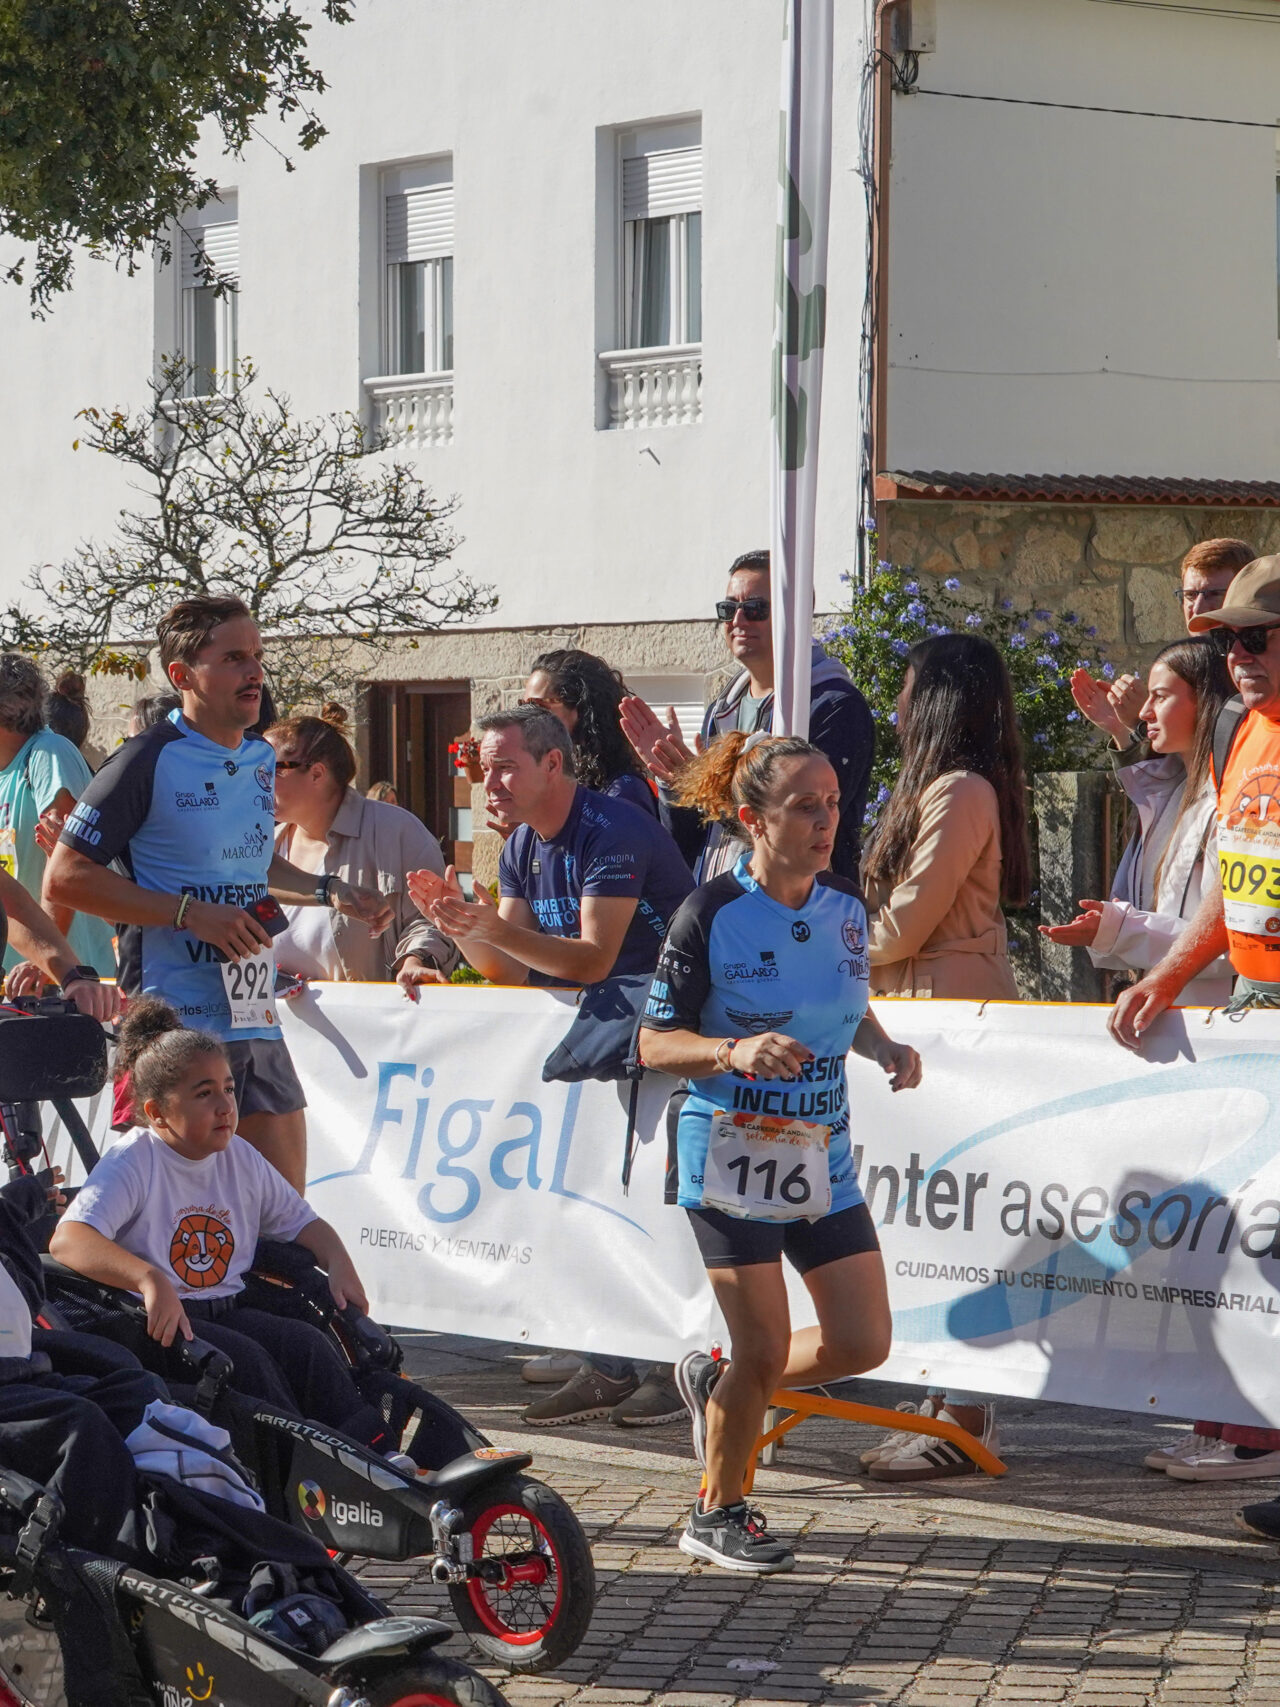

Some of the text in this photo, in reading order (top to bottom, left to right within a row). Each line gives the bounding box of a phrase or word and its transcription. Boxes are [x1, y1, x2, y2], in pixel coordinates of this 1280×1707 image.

[73, 801, 101, 825] BAR
[176, 797, 220, 808] GALLARDO
[221, 845, 263, 861] MARCOS
[227, 961, 269, 1001] 292
[724, 967, 780, 981] GALLARDO
[320, 1062, 620, 1224] Figal
[727, 1155, 811, 1205] 116
[360, 1227, 533, 1265] PUERTAS Y VENTANAS
[895, 1260, 1280, 1315] CUIDAMOS TU CRECIMIENTO EMPRESARIAL
[331, 1494, 384, 1528] igalia
[120, 1575, 229, 1624] RATHON
